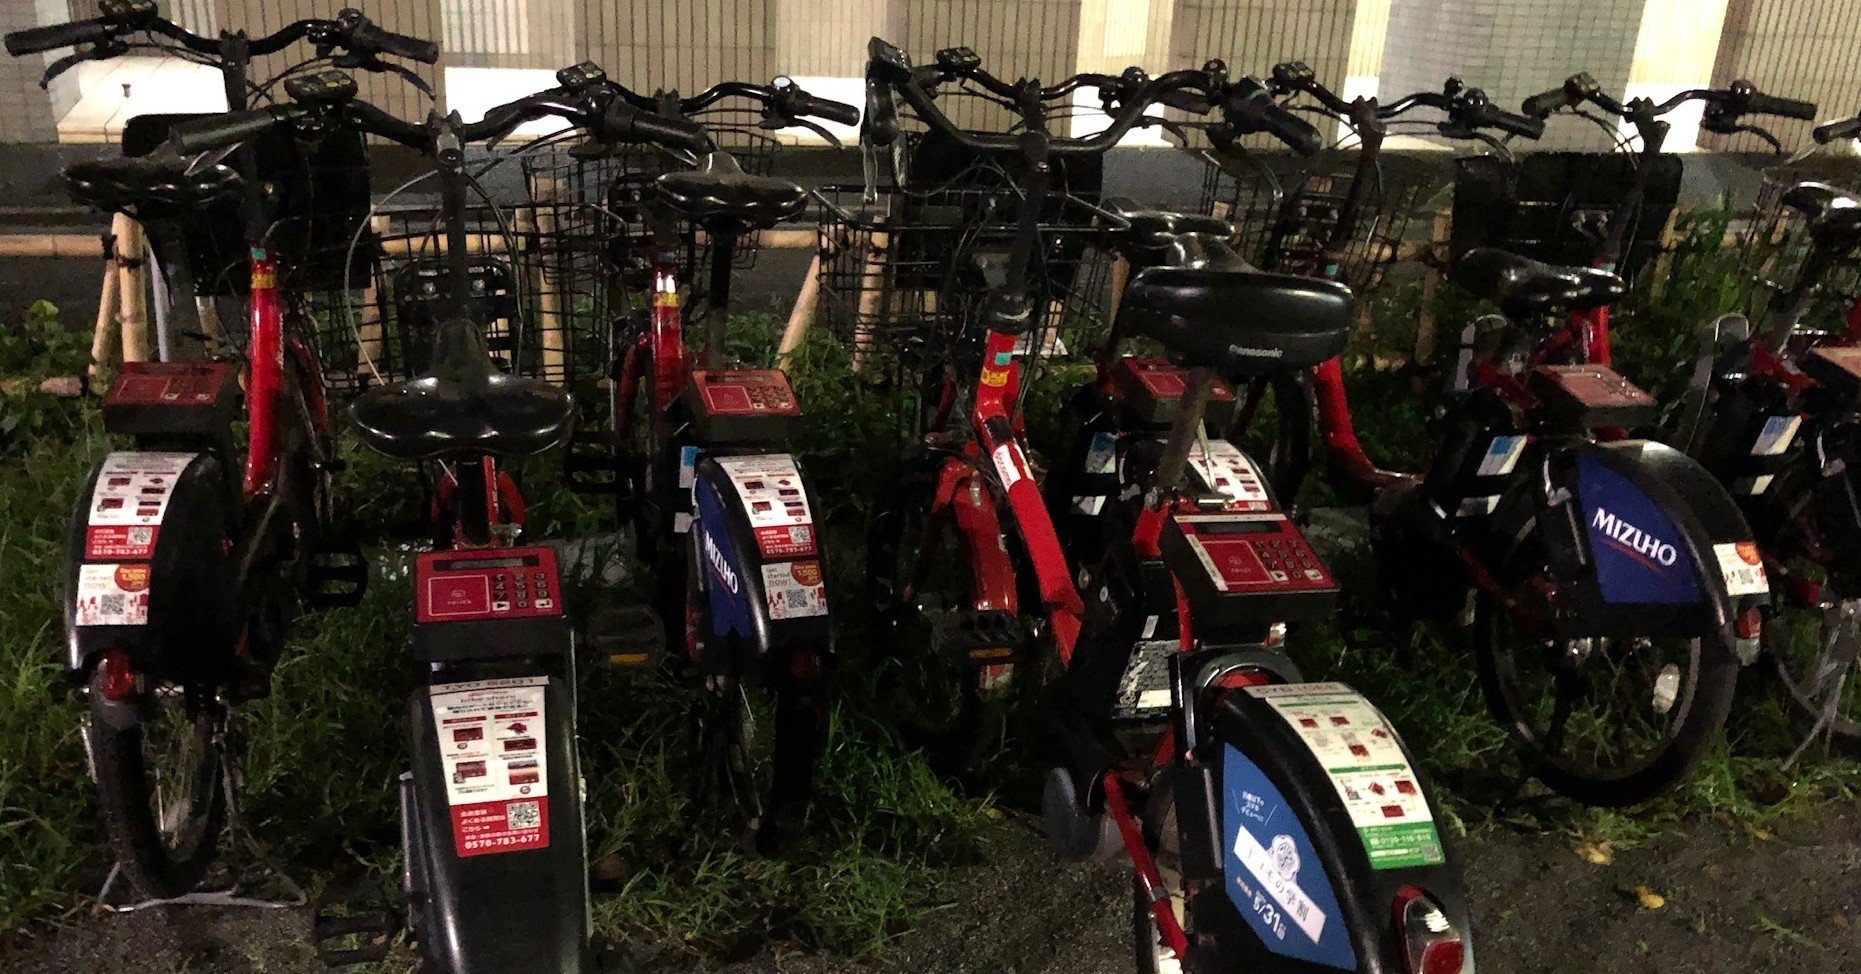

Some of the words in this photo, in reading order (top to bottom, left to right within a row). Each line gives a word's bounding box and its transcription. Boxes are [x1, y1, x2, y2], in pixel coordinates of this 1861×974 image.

[1229, 344, 1283, 359] Panasonic
[1592, 507, 1678, 567] MIZUHO
[704, 530, 739, 594] MIZUHO
[442, 682, 480, 691] TYO
[464, 833, 541, 850] 0570-783-677
